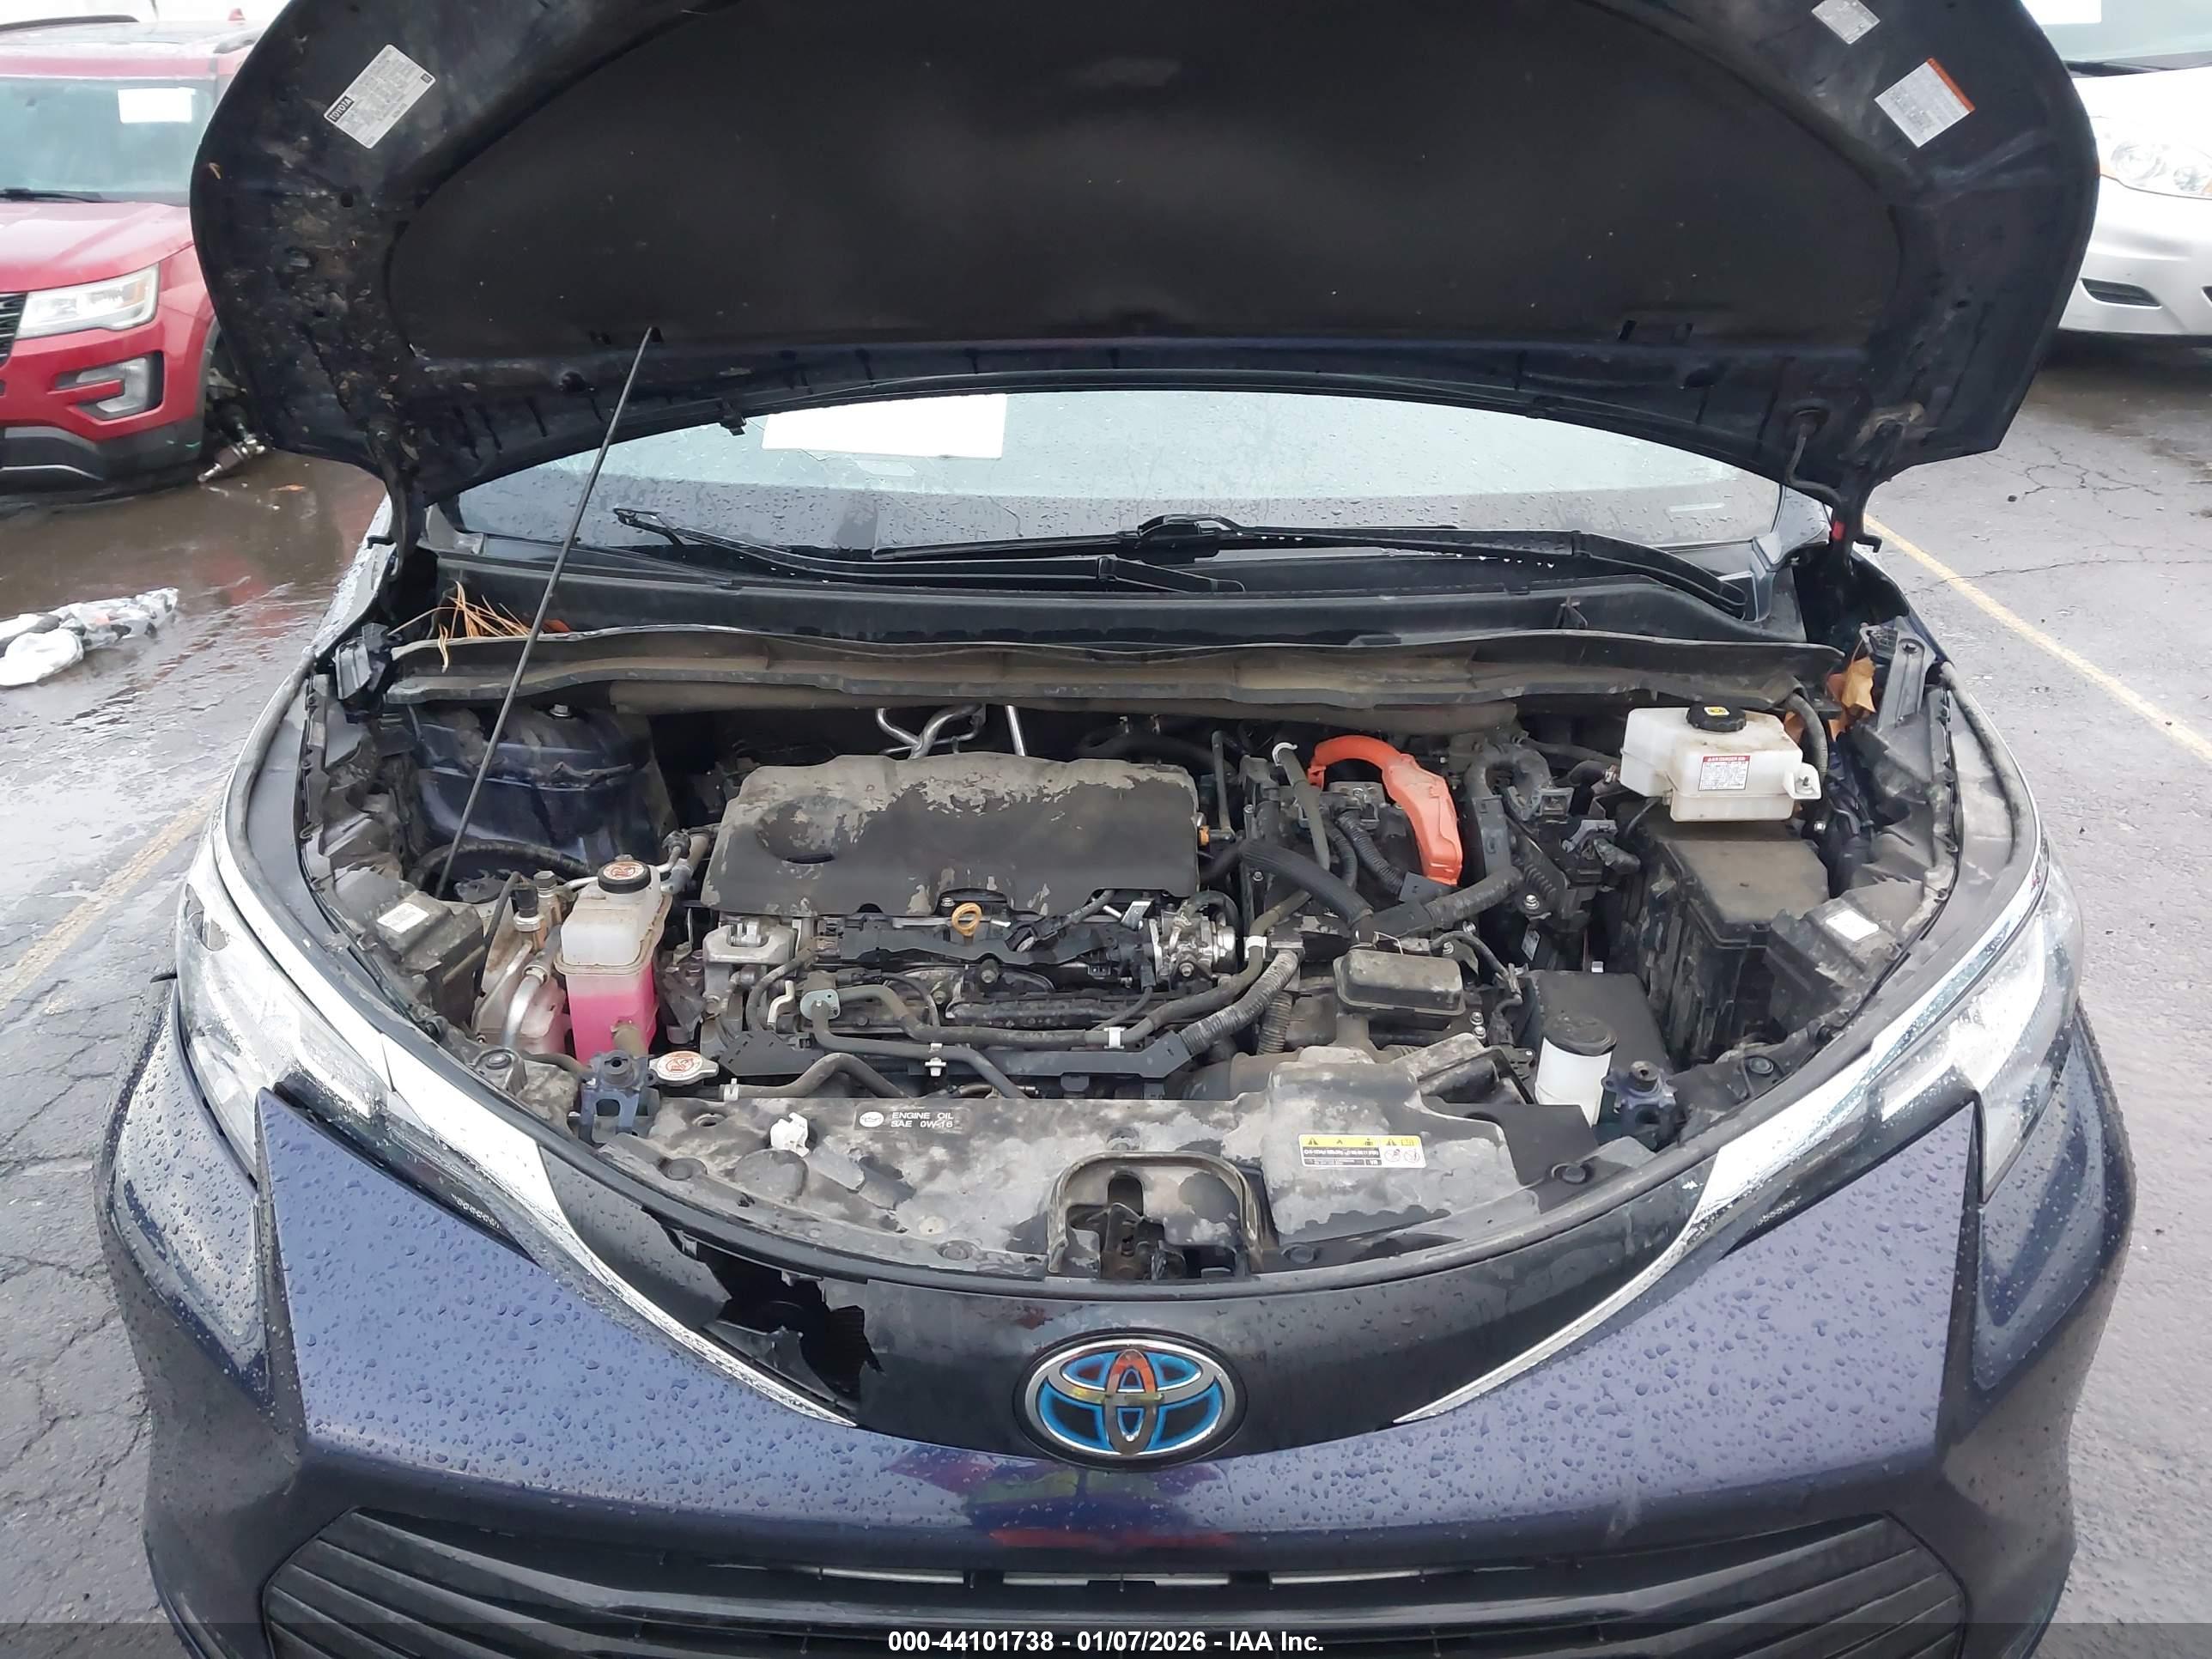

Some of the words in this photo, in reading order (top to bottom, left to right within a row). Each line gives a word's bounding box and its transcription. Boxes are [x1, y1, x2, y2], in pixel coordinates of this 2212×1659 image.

[328, 98, 352, 121] TOYOTA
[891, 1111, 931, 1120] ENGINE
[920, 1120, 953, 1128] 0W-16
